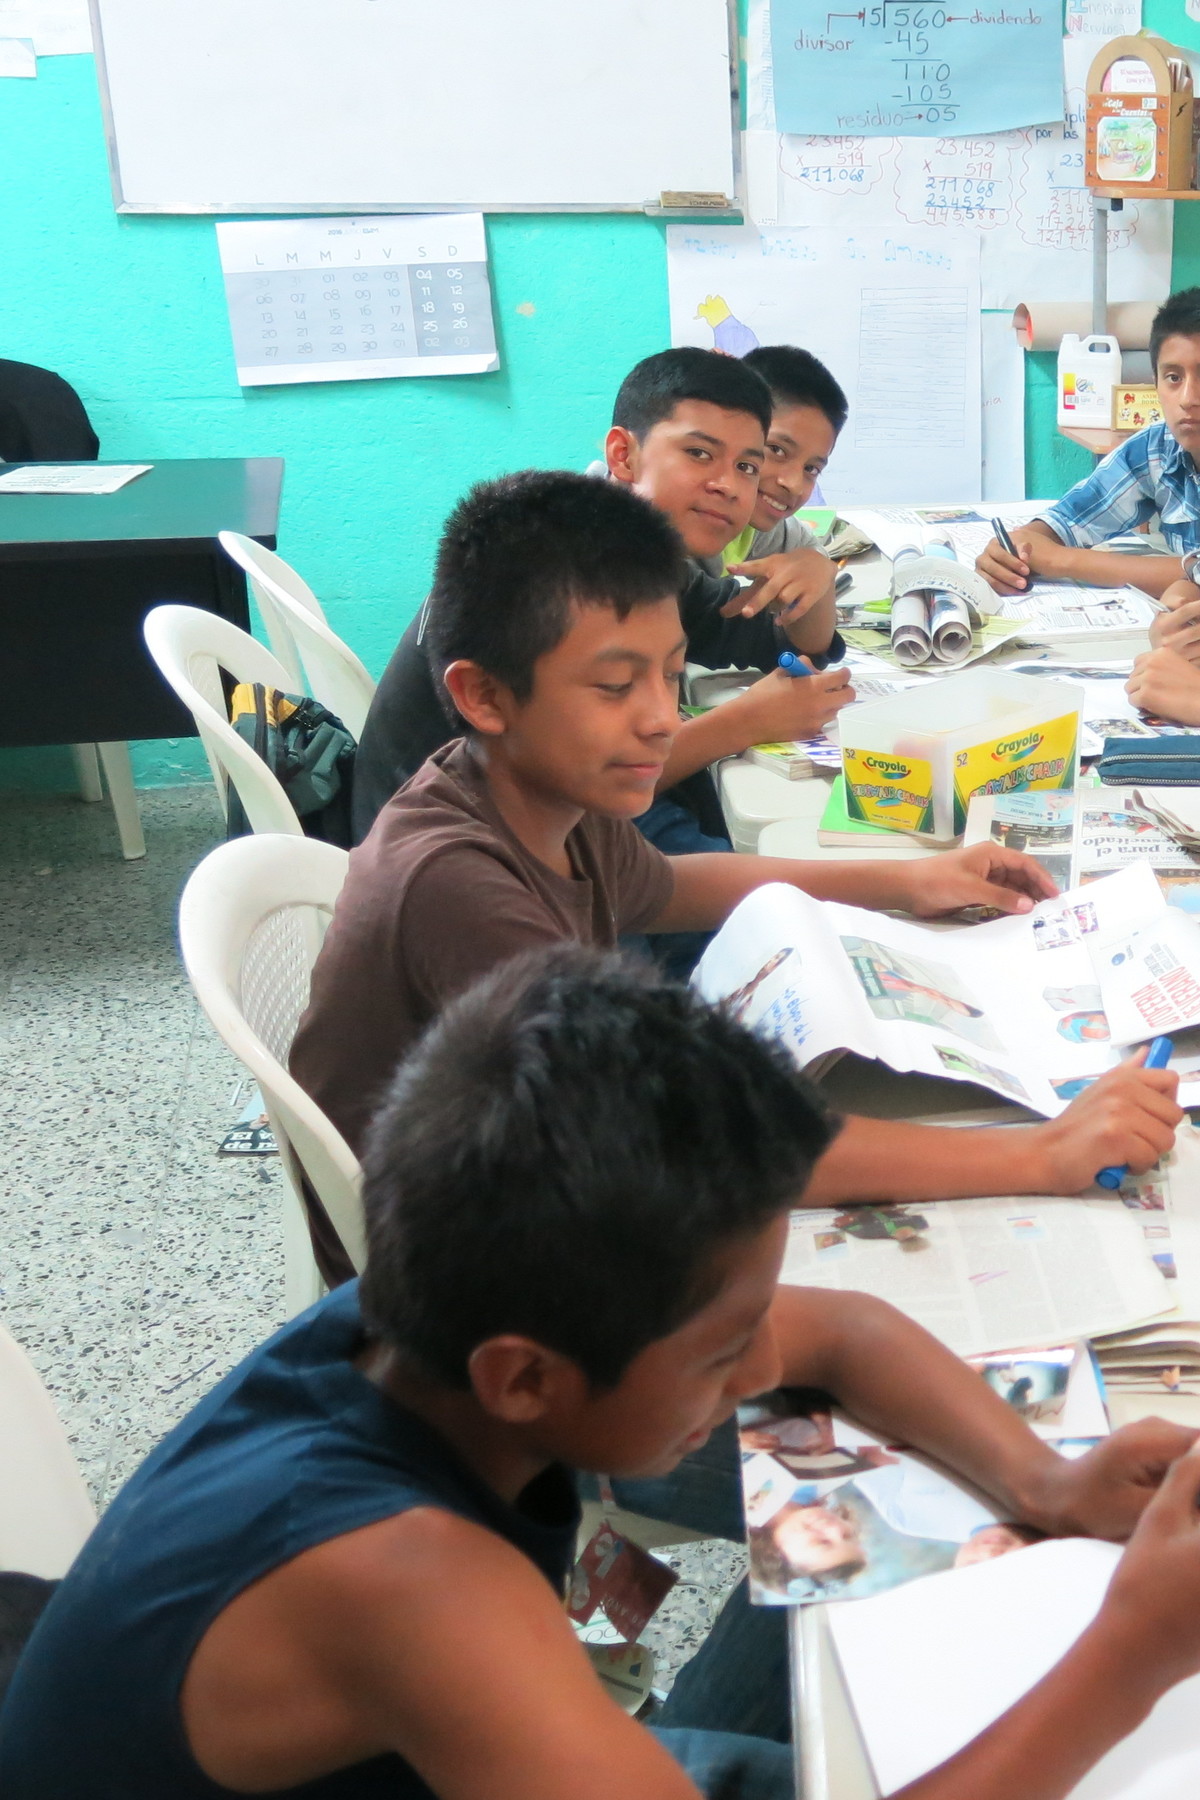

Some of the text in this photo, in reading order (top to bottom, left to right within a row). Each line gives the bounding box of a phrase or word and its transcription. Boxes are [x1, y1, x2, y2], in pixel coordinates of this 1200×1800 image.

[893, 8, 946, 28] 560
[970, 9, 1042, 25] dividendo
[794, 30, 854, 52] divisor
[837, 103, 956, 128] residuo 05
[1035, 127, 1053, 144] por
[837, 153, 864, 166] 519
[964, 163, 993, 178] 519
[255, 254, 264, 265] L
[286, 252, 298, 264] M
[320, 250, 332, 262] M
[382, 248, 392, 259] V
[418, 246, 427, 258] S
[448, 245, 458, 256] D
[415, 269, 433, 280] 04
[446, 268, 463, 280] 05
[422, 286, 431, 296] 11
[451, 285, 463, 296] 12
[421, 302, 465, 314] 18 19
[423, 320, 438, 332] 25
[452, 317, 468, 329] 26
[995, 732, 1041, 756] Crayola
[845, 749, 857, 760] 52
[957, 753, 968, 767] 52
[866, 756, 908, 774] Crayola
[1024, 757, 1066, 783] CHALK
[1096, 844, 1160, 858] para el
